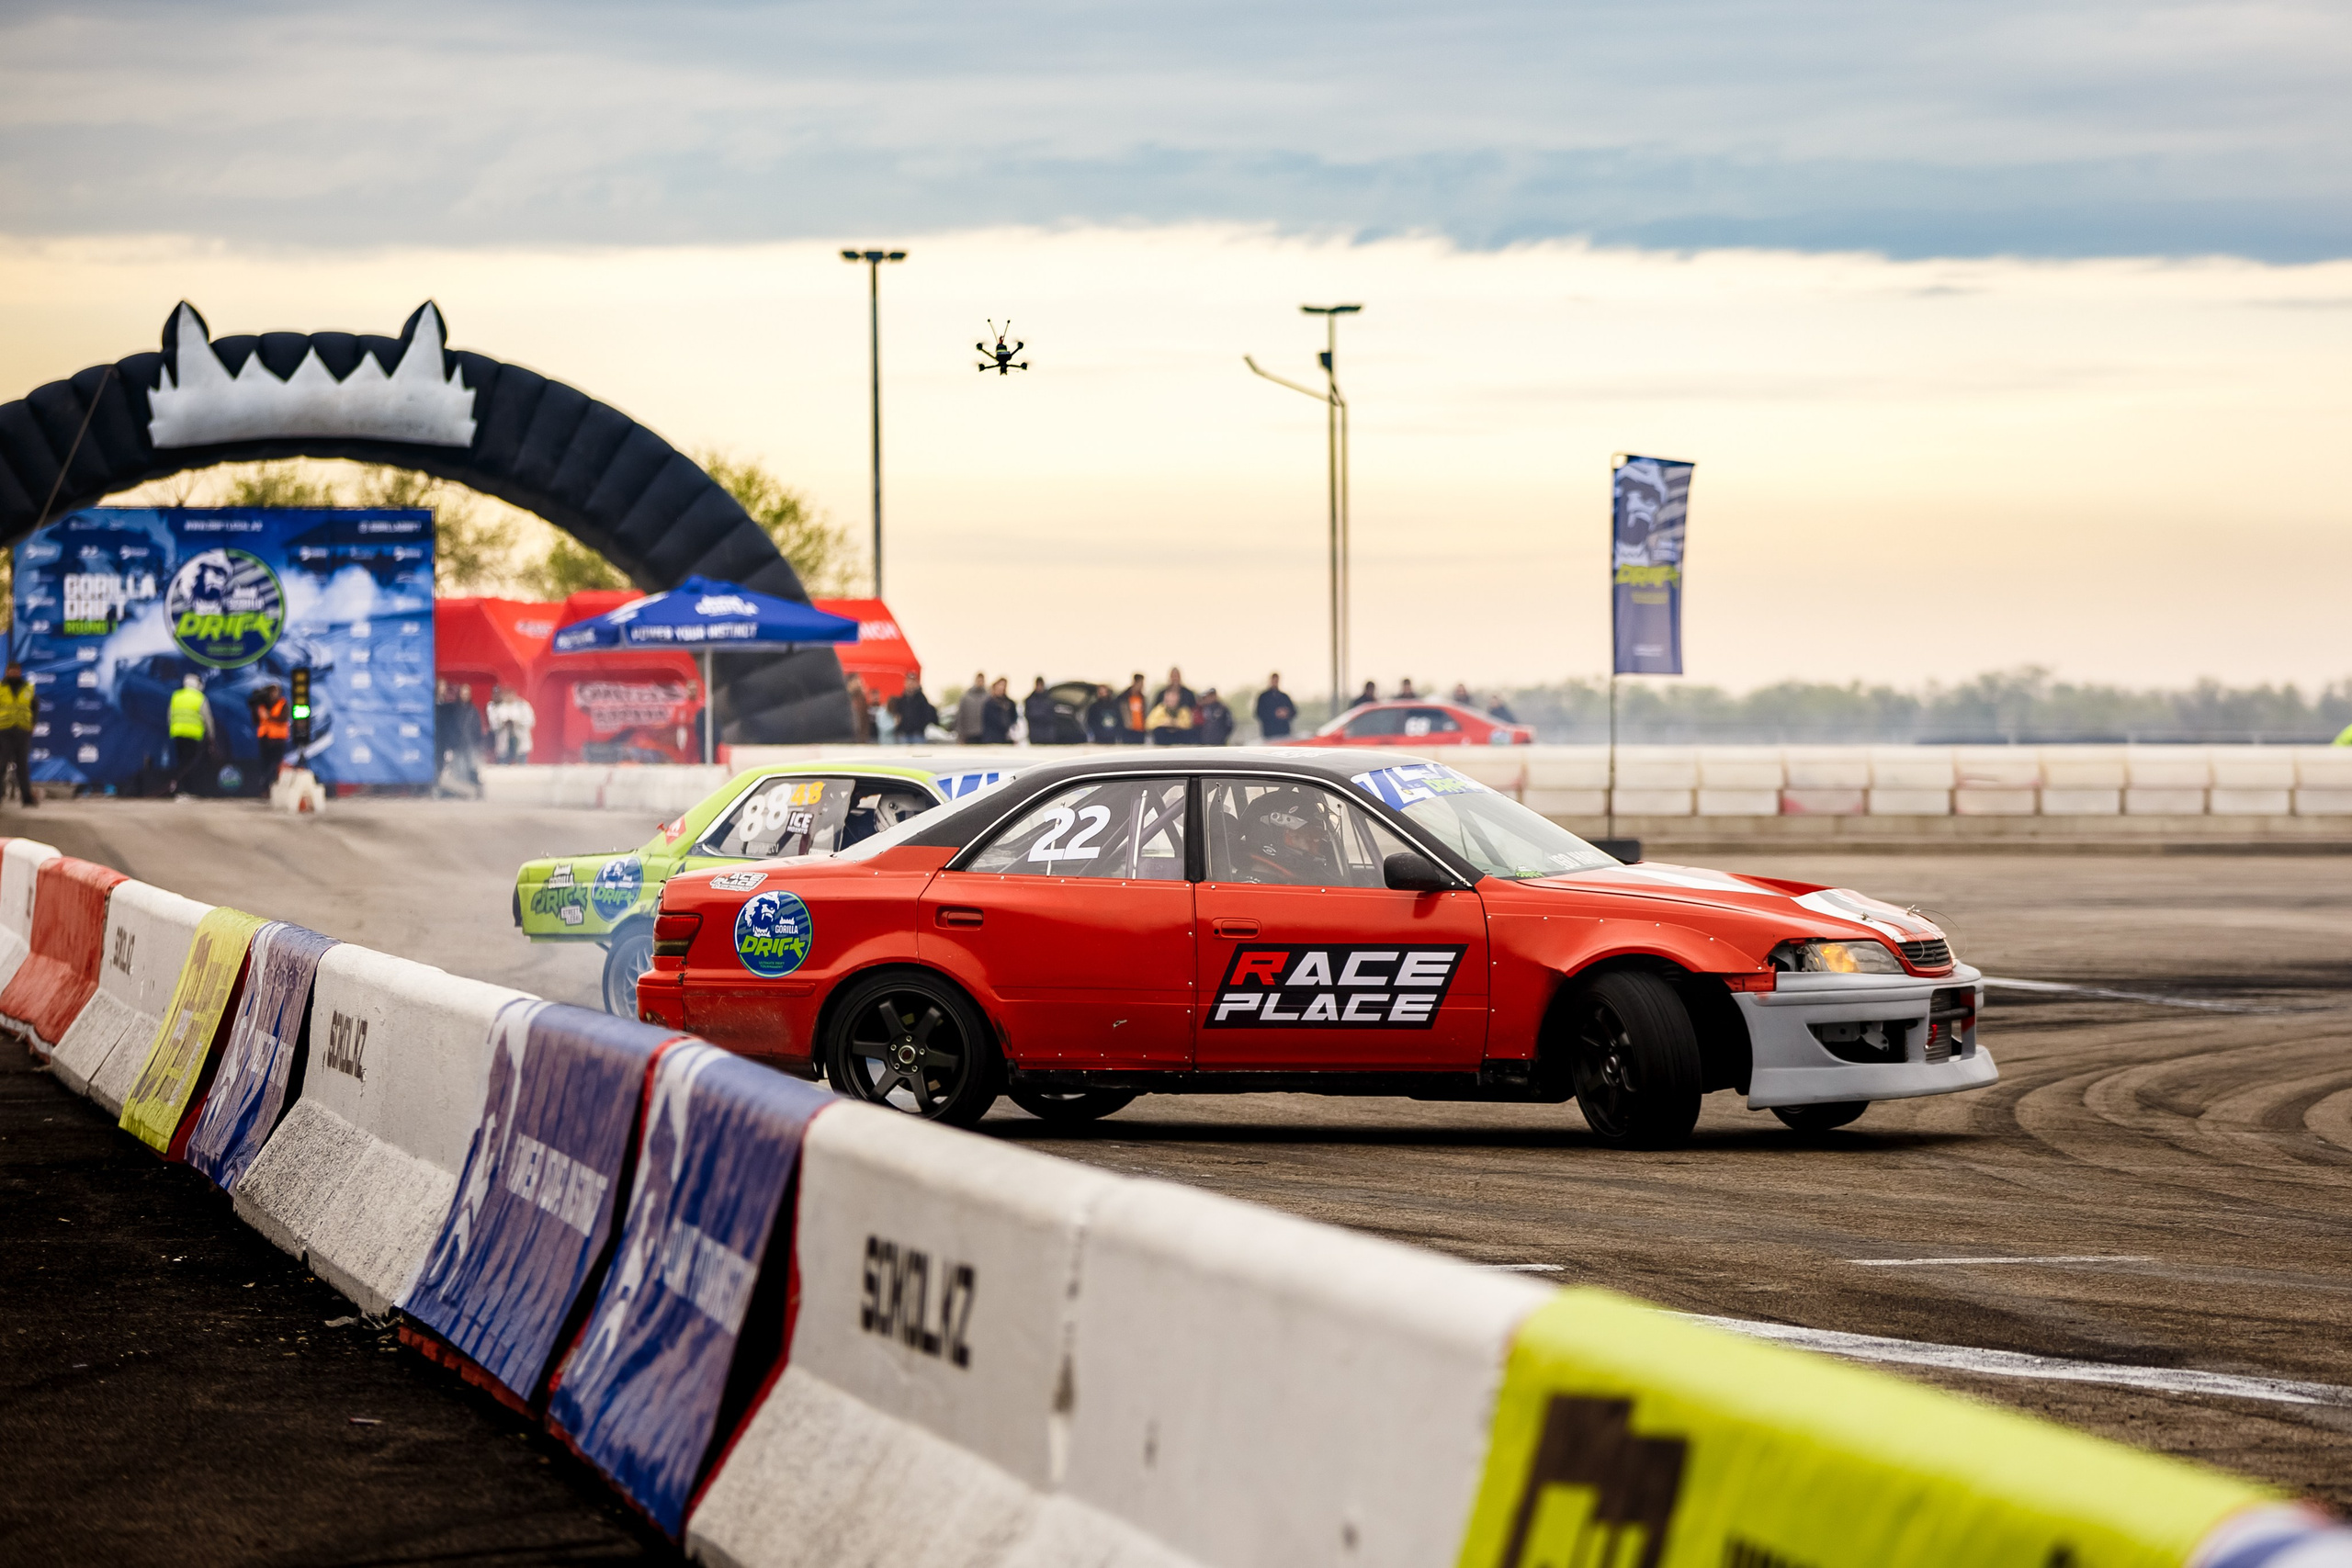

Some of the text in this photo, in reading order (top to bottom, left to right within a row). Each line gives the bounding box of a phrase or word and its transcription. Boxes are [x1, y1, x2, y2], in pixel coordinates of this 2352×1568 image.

[63, 573, 157, 600] GORILLA
[175, 610, 275, 640] DRIFT
[791, 781, 824, 807] 48
[740, 783, 791, 841] 88
[789, 812, 813, 829] ICE
[1027, 805, 1111, 862] 22
[548, 874, 574, 889] GORILLA
[595, 887, 635, 906] DRIFT
[775, 924, 798, 934] GORILLA
[740, 935, 805, 959] DRIFT
[1229, 952, 1456, 986] RACE
[1215, 993, 1437, 1021] PLACE
